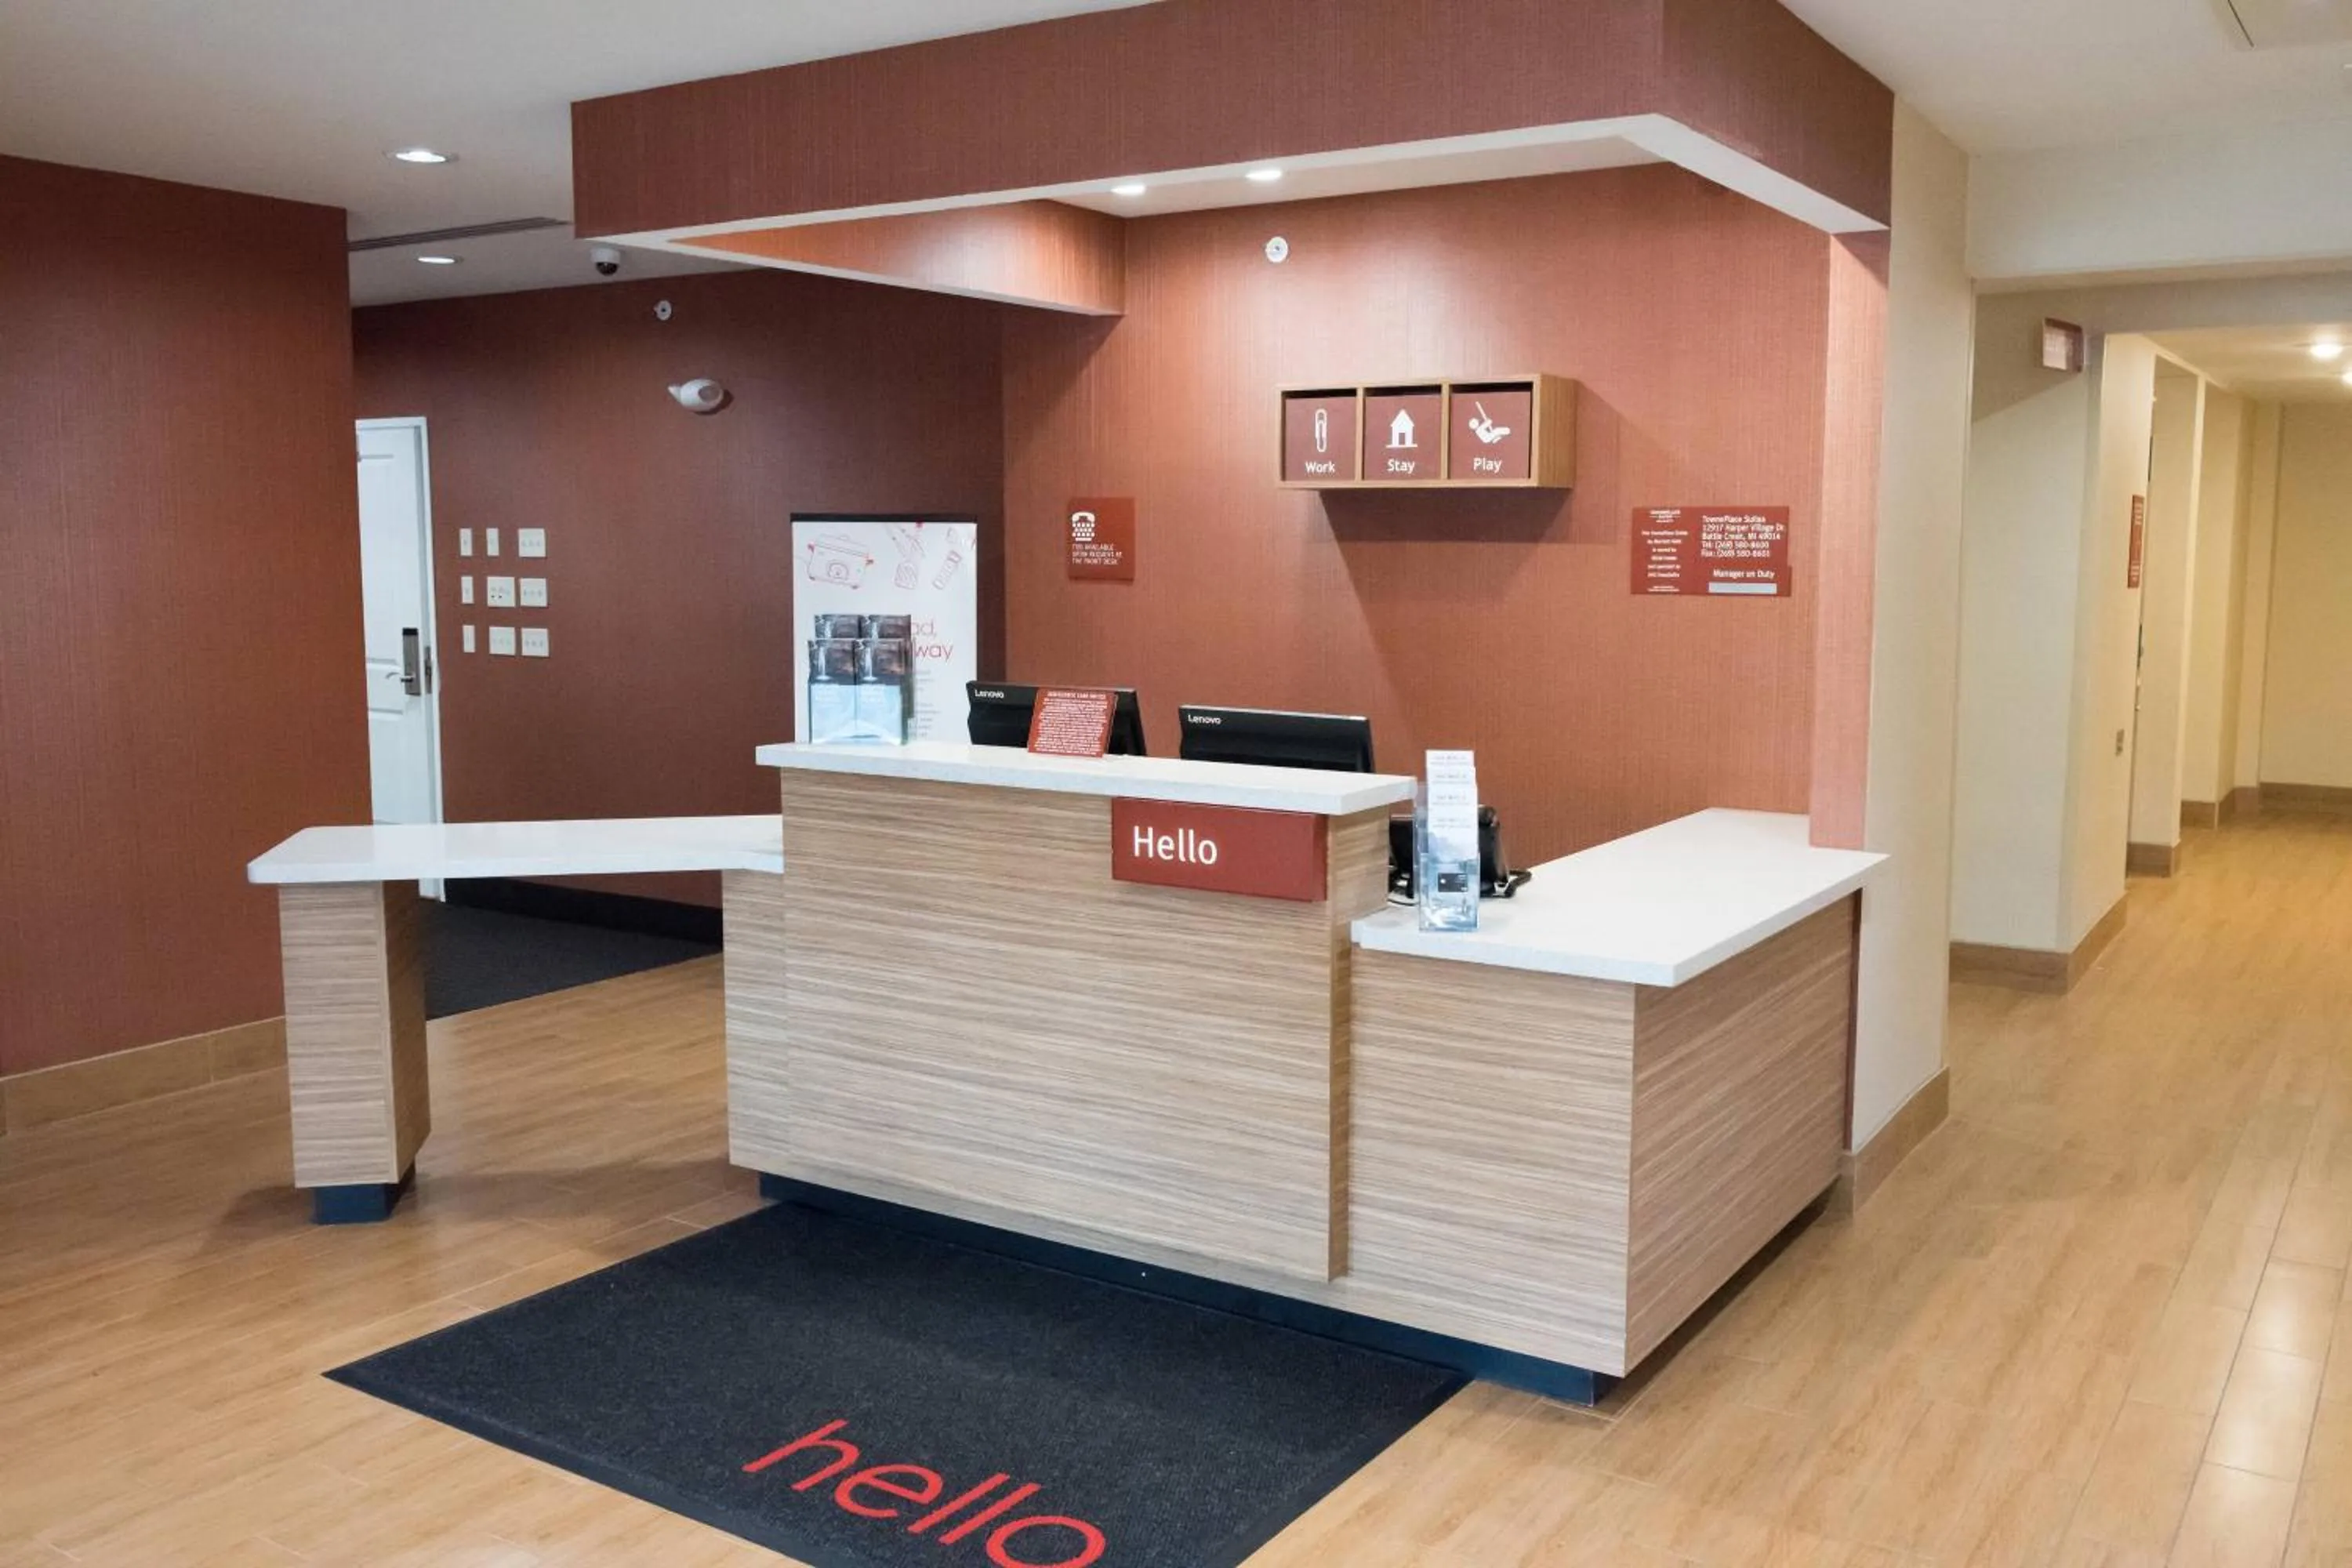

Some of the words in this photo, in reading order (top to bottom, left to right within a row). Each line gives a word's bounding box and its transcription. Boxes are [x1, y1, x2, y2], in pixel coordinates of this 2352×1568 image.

[1305, 460, 1335, 474] Work
[1387, 459, 1416, 474] Stay
[1473, 457, 1502, 472] Play
[1713, 568, 1744, 579] Manager
[1757, 569, 1775, 580] Duty
[975, 689, 1004, 699] Lenovo
[1187, 713, 1221, 724] Lenovo
[1134, 826, 1218, 865] Hello
[742, 1419, 1106, 1568] hello
